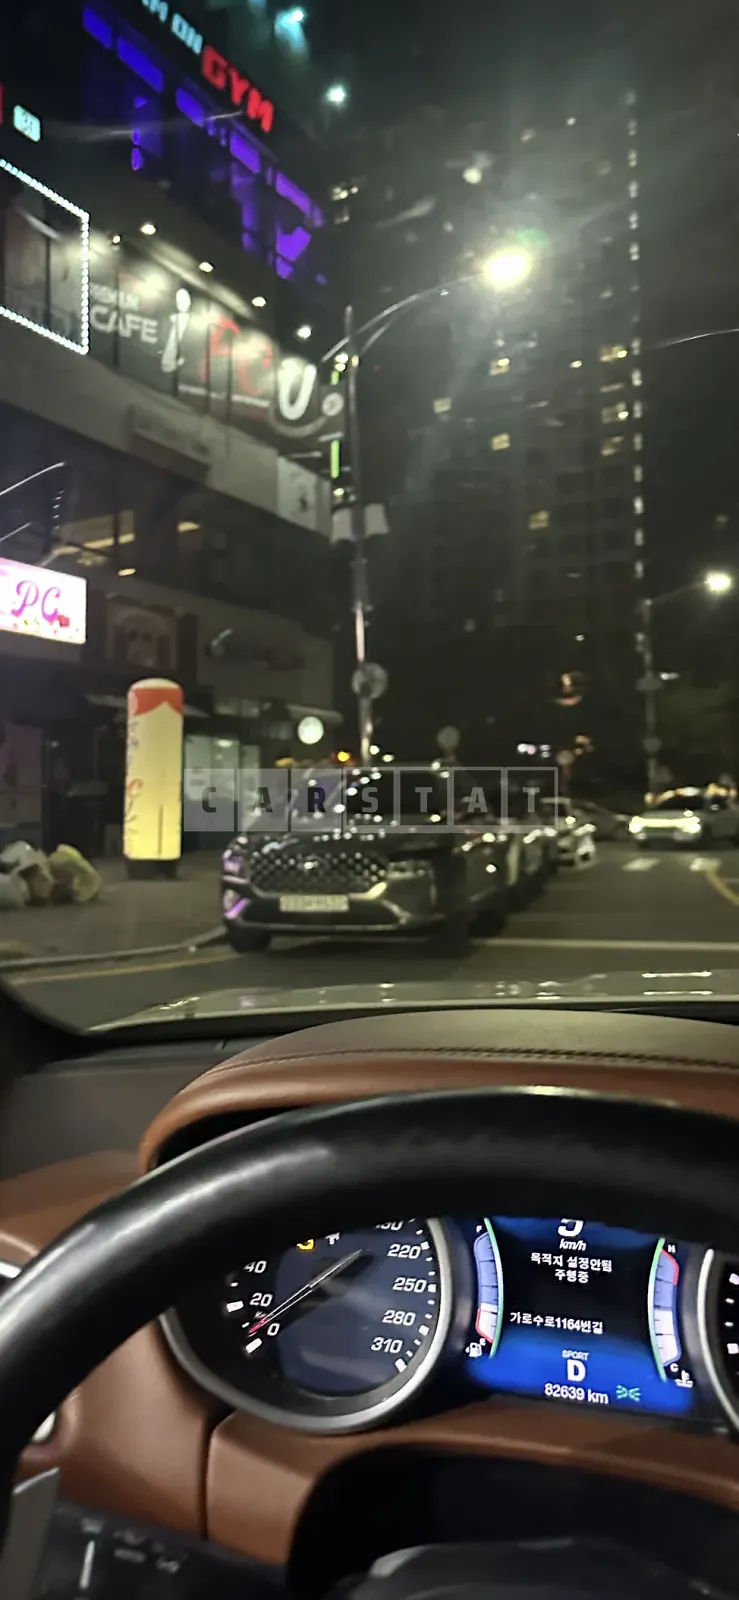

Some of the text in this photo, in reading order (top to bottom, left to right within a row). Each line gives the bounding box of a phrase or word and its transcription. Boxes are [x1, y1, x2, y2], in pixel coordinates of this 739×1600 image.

[171, 13, 203, 54] ON
[202, 45, 274, 132] GYM
[89, 304, 158, 343] CAFE
[9, 580, 61, 624] PC
[387, 1243, 421, 1260] 220
[559, 1238, 587, 1251] km/h
[244, 1260, 268, 1274] 40
[530, 1252, 613, 1273] 목적지 설정안됨
[392, 1277, 428, 1293] 250
[554, 1269, 589, 1284] 주행중
[249, 1292, 274, 1307] 20
[382, 1309, 417, 1326] 280
[509, 1312, 604, 1335] 가로수로1164번길
[266, 1322, 281, 1337] 0
[370, 1336, 403, 1354] 310
[561, 1349, 590, 1361] SPORT
[566, 1358, 587, 1382] D
[544, 1382, 610, 1405] 82639 km
